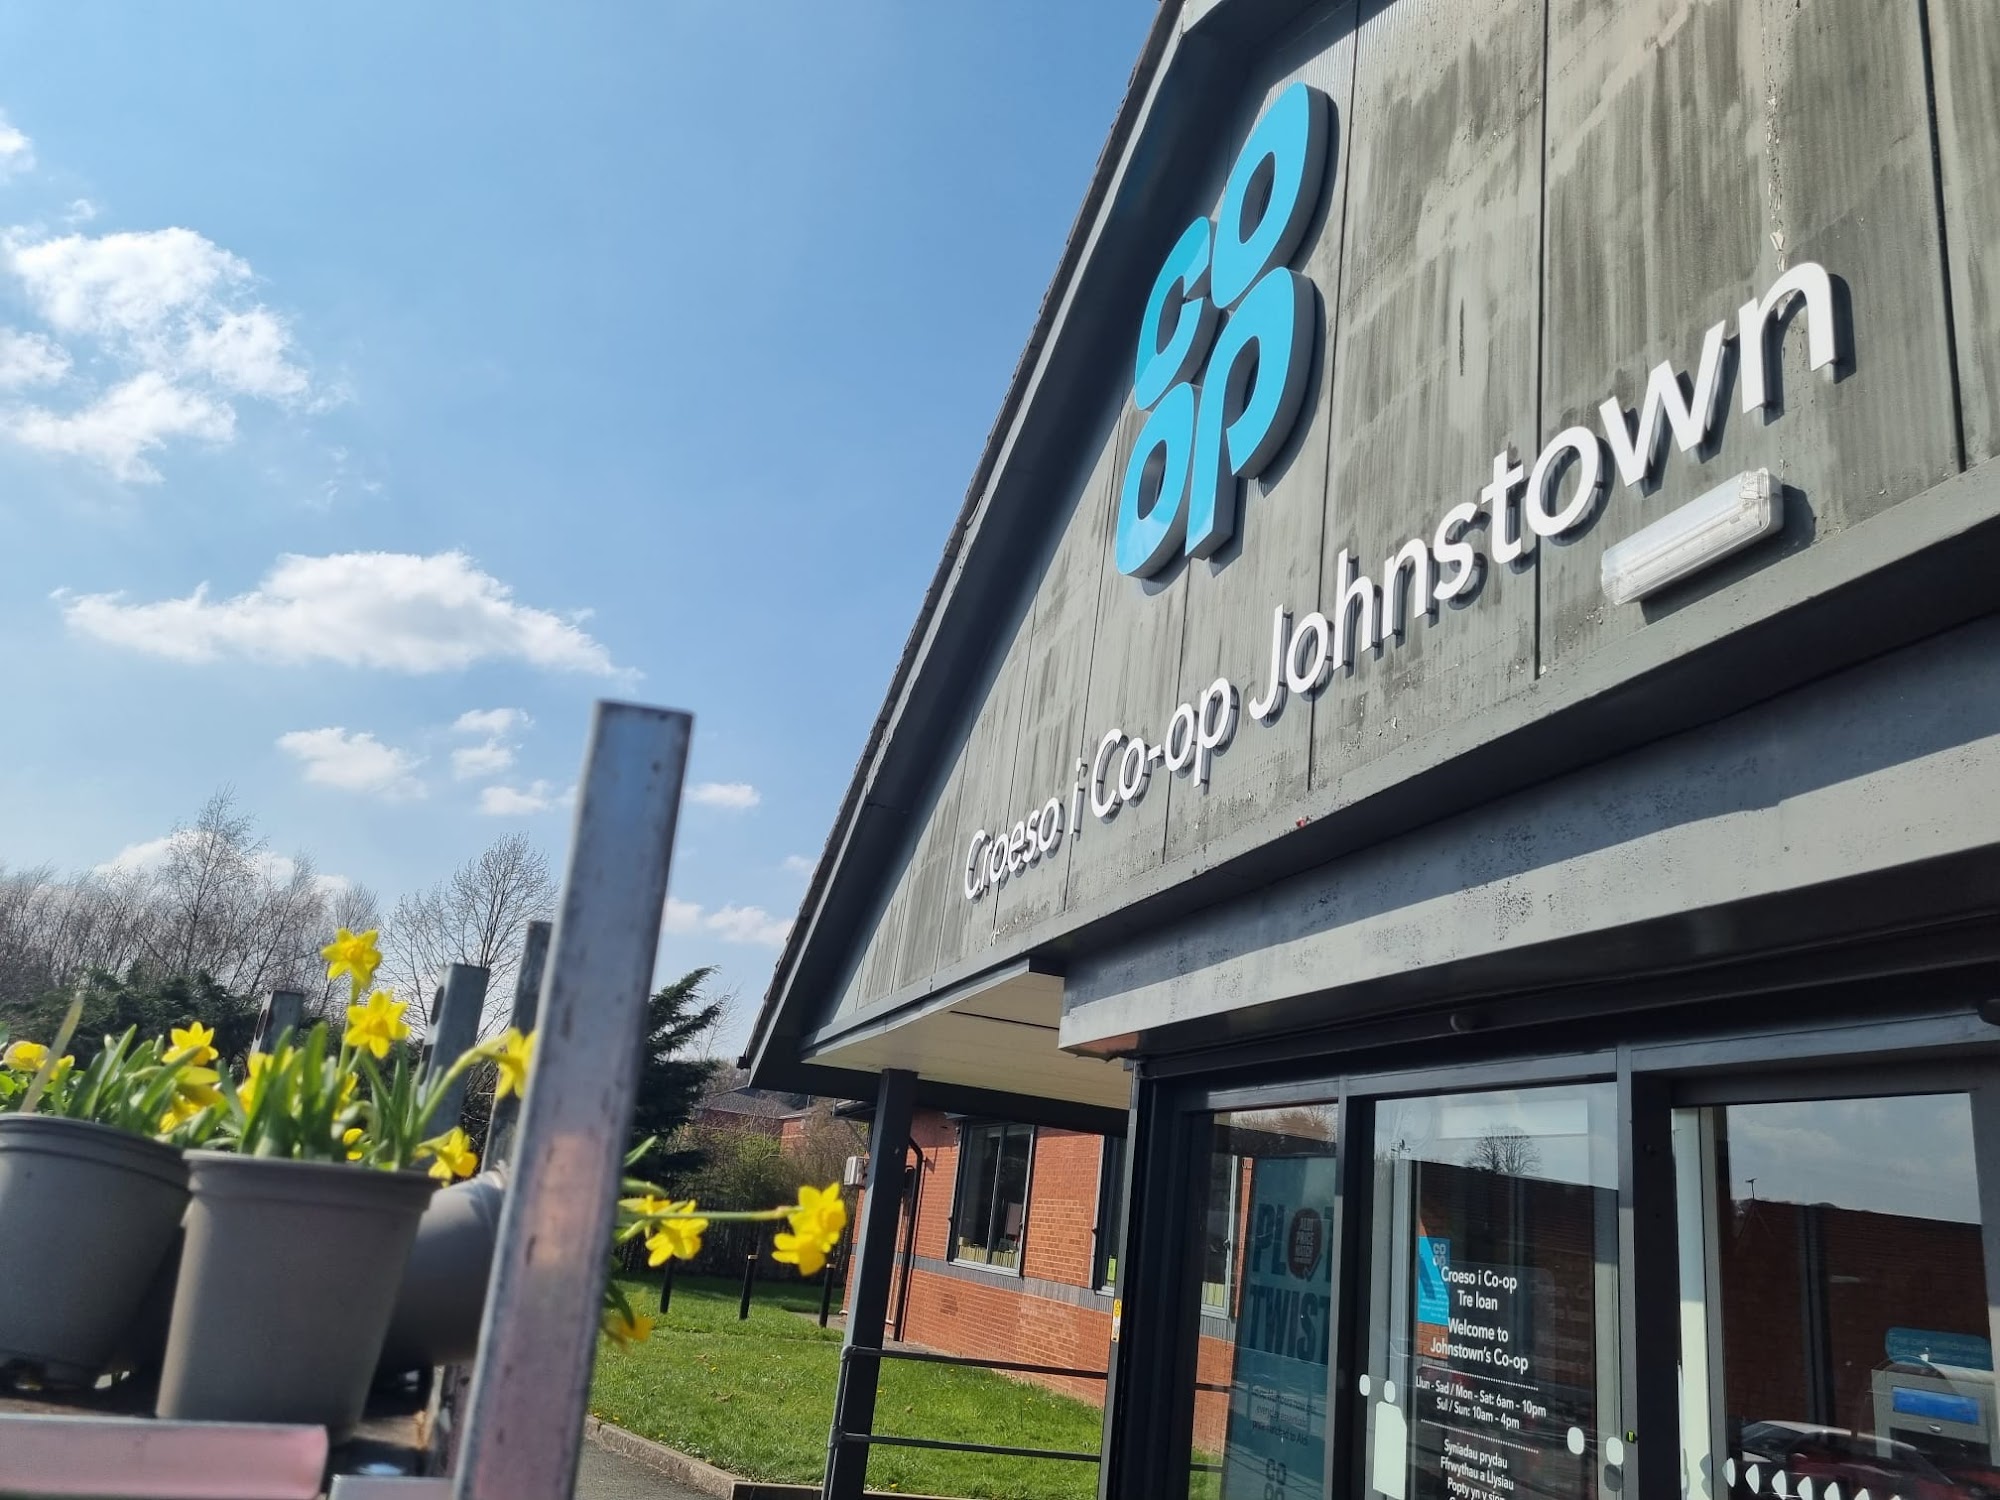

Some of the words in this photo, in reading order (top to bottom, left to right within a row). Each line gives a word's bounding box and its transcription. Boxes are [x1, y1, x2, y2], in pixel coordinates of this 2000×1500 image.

[965, 797, 1060, 900] Croeso
[1069, 757, 1083, 835] i
[1090, 677, 1231, 818] Co-op
[1248, 261, 1838, 721] Johnstown
[1441, 1266, 1476, 1284] Croeso
[1484, 1270, 1517, 1294] Co-op
[1457, 1290, 1473, 1307] Tre
[1447, 1317, 1495, 1340] Welcome
[1497, 1327, 1508, 1342] to
[1430, 1337, 1491, 1363] Johnstown's
[1494, 1348, 1528, 1374] Co-op
[1415, 1375, 1430, 1390] Llun
[1435, 1380, 1449, 1395] Sad
[1456, 1385, 1473, 1400] Mon
[1480, 1390, 1495, 1406] Sat:
[1496, 1394, 1514, 1410] 6am
[1522, 1400, 1547, 1418] 10pm
[1436, 1397, 1448, 1411] Sul
[1454, 1401, 1471, 1417] Sun:
[1472, 1406, 1493, 1422] 10am
[1500, 1413, 1520, 1430] 4pm
[1444, 1438, 1478, 1460] Syniadau
[1480, 1452, 1508, 1469] prydau
[1440, 1456, 1478, 1478] Ffrwythau
[1487, 1470, 1514, 1491] Llysiau
[1447, 1477, 1469, 1498] Popty
